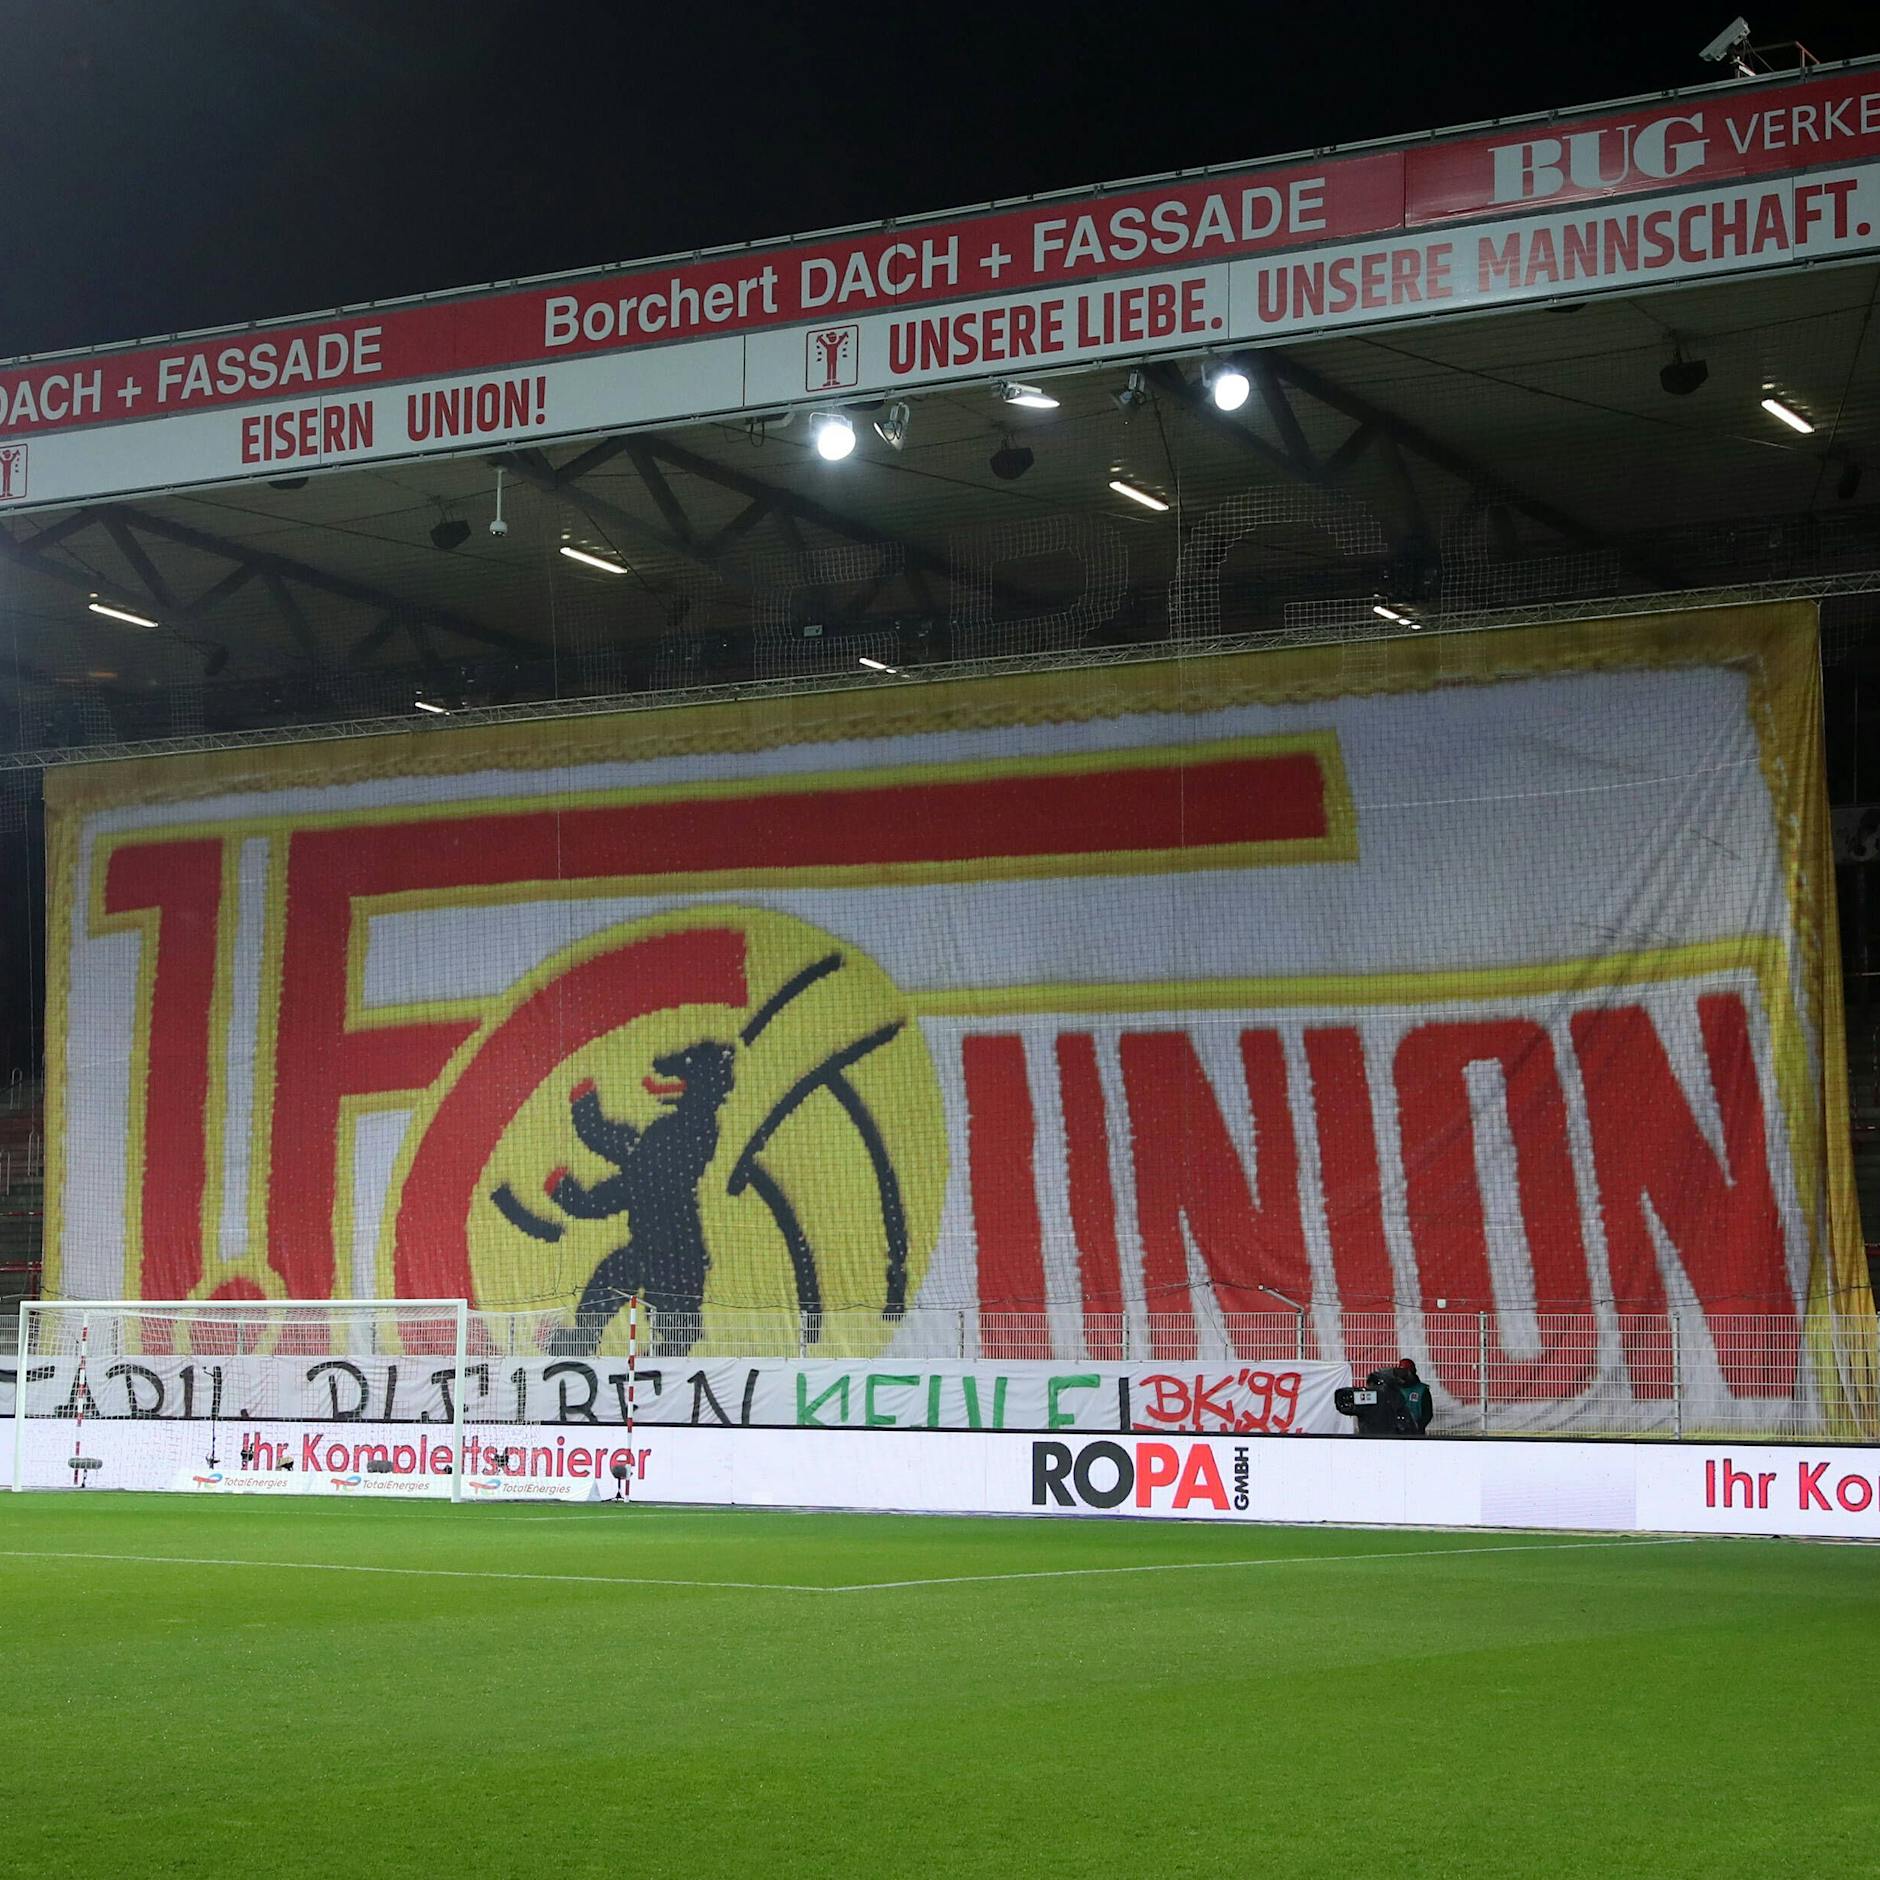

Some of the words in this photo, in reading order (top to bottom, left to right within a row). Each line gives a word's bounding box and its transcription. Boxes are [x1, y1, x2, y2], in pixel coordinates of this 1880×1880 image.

[1487, 112, 1711, 205] BUG
[1725, 93, 1880, 155] VERKE
[544, 265, 778, 348] Borchert
[801, 236, 958, 309] DACH
[979, 244, 1012, 280] +
[1033, 178, 1326, 272] FASSADE
[1257, 243, 1453, 324] UNSERE
[1478, 179, 1872, 294] MANNSCHAFT.
[889, 299, 1066, 375] UNSERE
[1077, 278, 1224, 347] LIEBE.
[0, 369, 102, 425] ACH
[158, 326, 383, 403] FASSADE
[241, 400, 373, 464] EISERN
[407, 376, 547, 442] UNION!
[223, 1477, 288, 1489] TotalEnergies
[363, 1479, 430, 1491] TotalEnergies
[502, 1483, 571, 1495] TotalEnergies
[1032, 1440, 1231, 1511] ROPA
[1234, 1446, 1250, 1511] GMBH
[1705, 1458, 1777, 1509] Ihr
[1798, 1461, 1880, 1512] Ko
